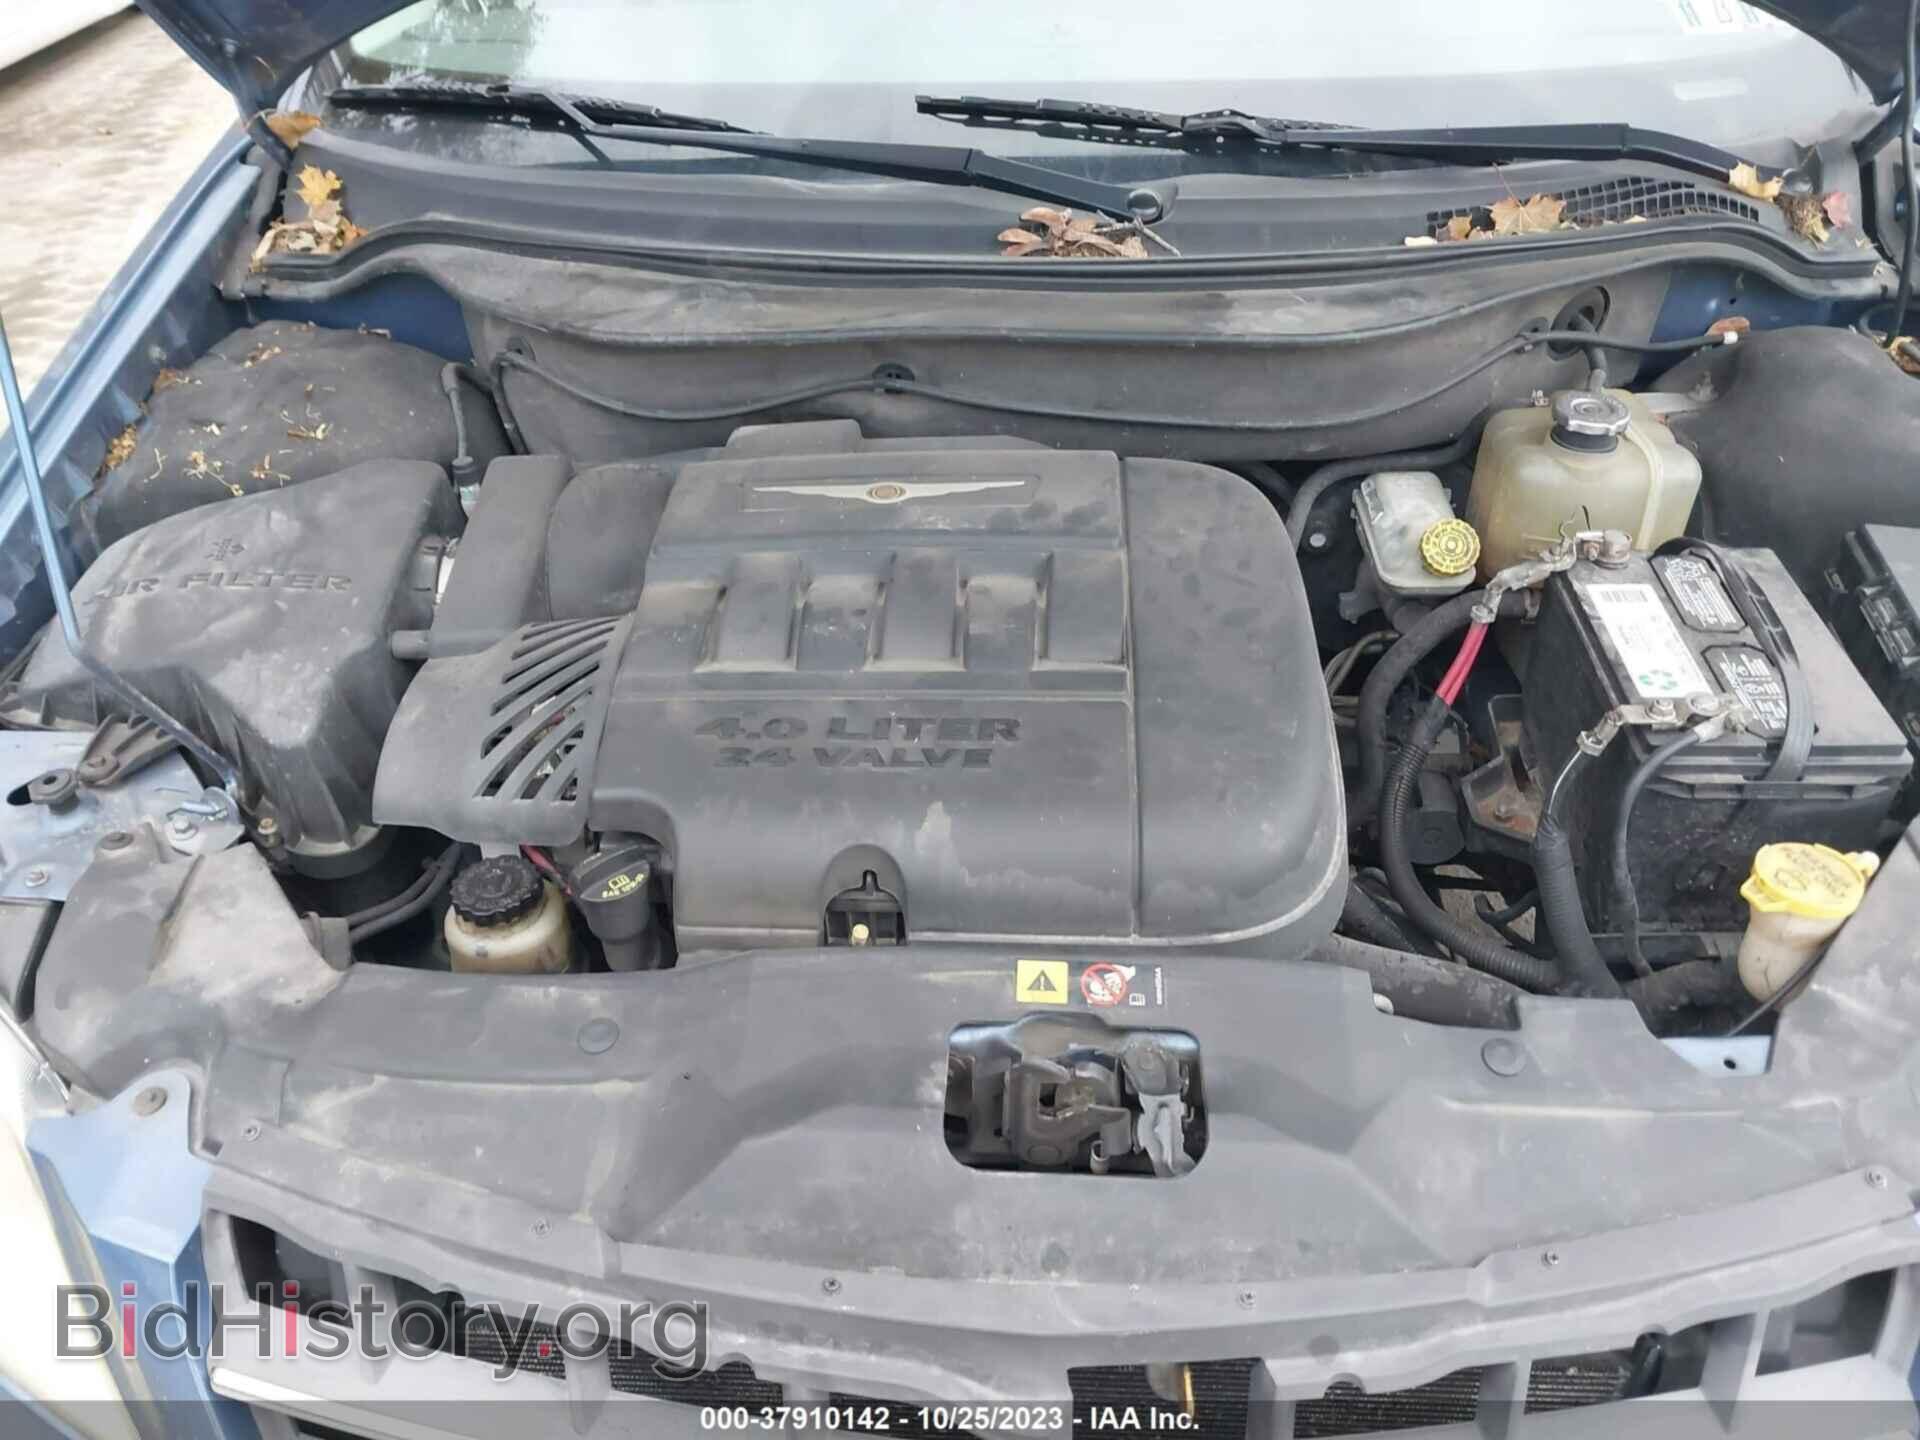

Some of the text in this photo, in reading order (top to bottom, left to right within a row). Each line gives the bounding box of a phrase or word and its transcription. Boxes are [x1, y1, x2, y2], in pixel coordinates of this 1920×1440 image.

[176, 571, 351, 592] FILTER
[695, 717, 1022, 741] 4.0 LITER
[812, 747, 993, 768] VALVE
